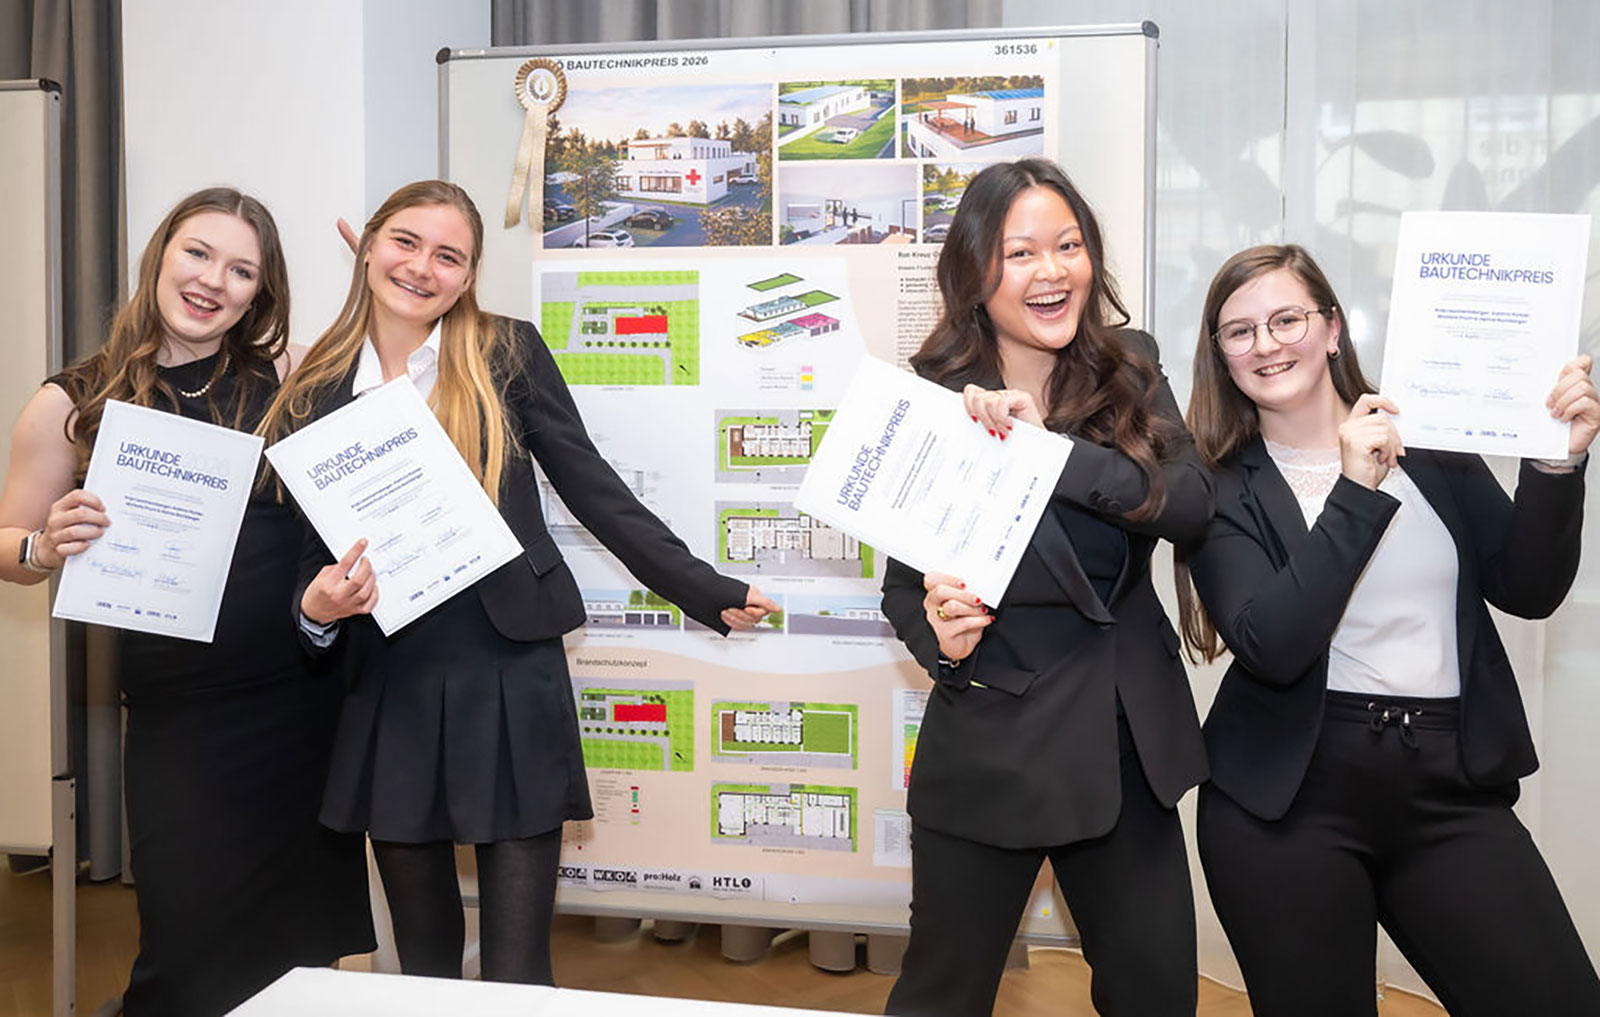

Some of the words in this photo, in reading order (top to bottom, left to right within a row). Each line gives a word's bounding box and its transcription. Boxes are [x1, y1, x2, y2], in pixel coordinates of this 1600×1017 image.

[994, 44, 1038, 55] 361536
[567, 57, 679, 70] BAUTECHNIKPREIS
[682, 56, 709, 66] 2026
[1421, 253, 1491, 267] URKUNDE
[1419, 265, 1554, 284] BAUTECHNIKPREIS
[119, 441, 182, 466] URKUNDE
[306, 441, 366, 480] URKUNDE
[313, 427, 418, 491] BAUTECHNIKPREIS
[847, 398, 911, 512] BAUTECHNIKPREIS
[116, 453, 229, 491] BAUTECHNIKPREIS
[836, 444, 875, 506] URKUNDE
[643, 873, 681, 882] pro:Holz
